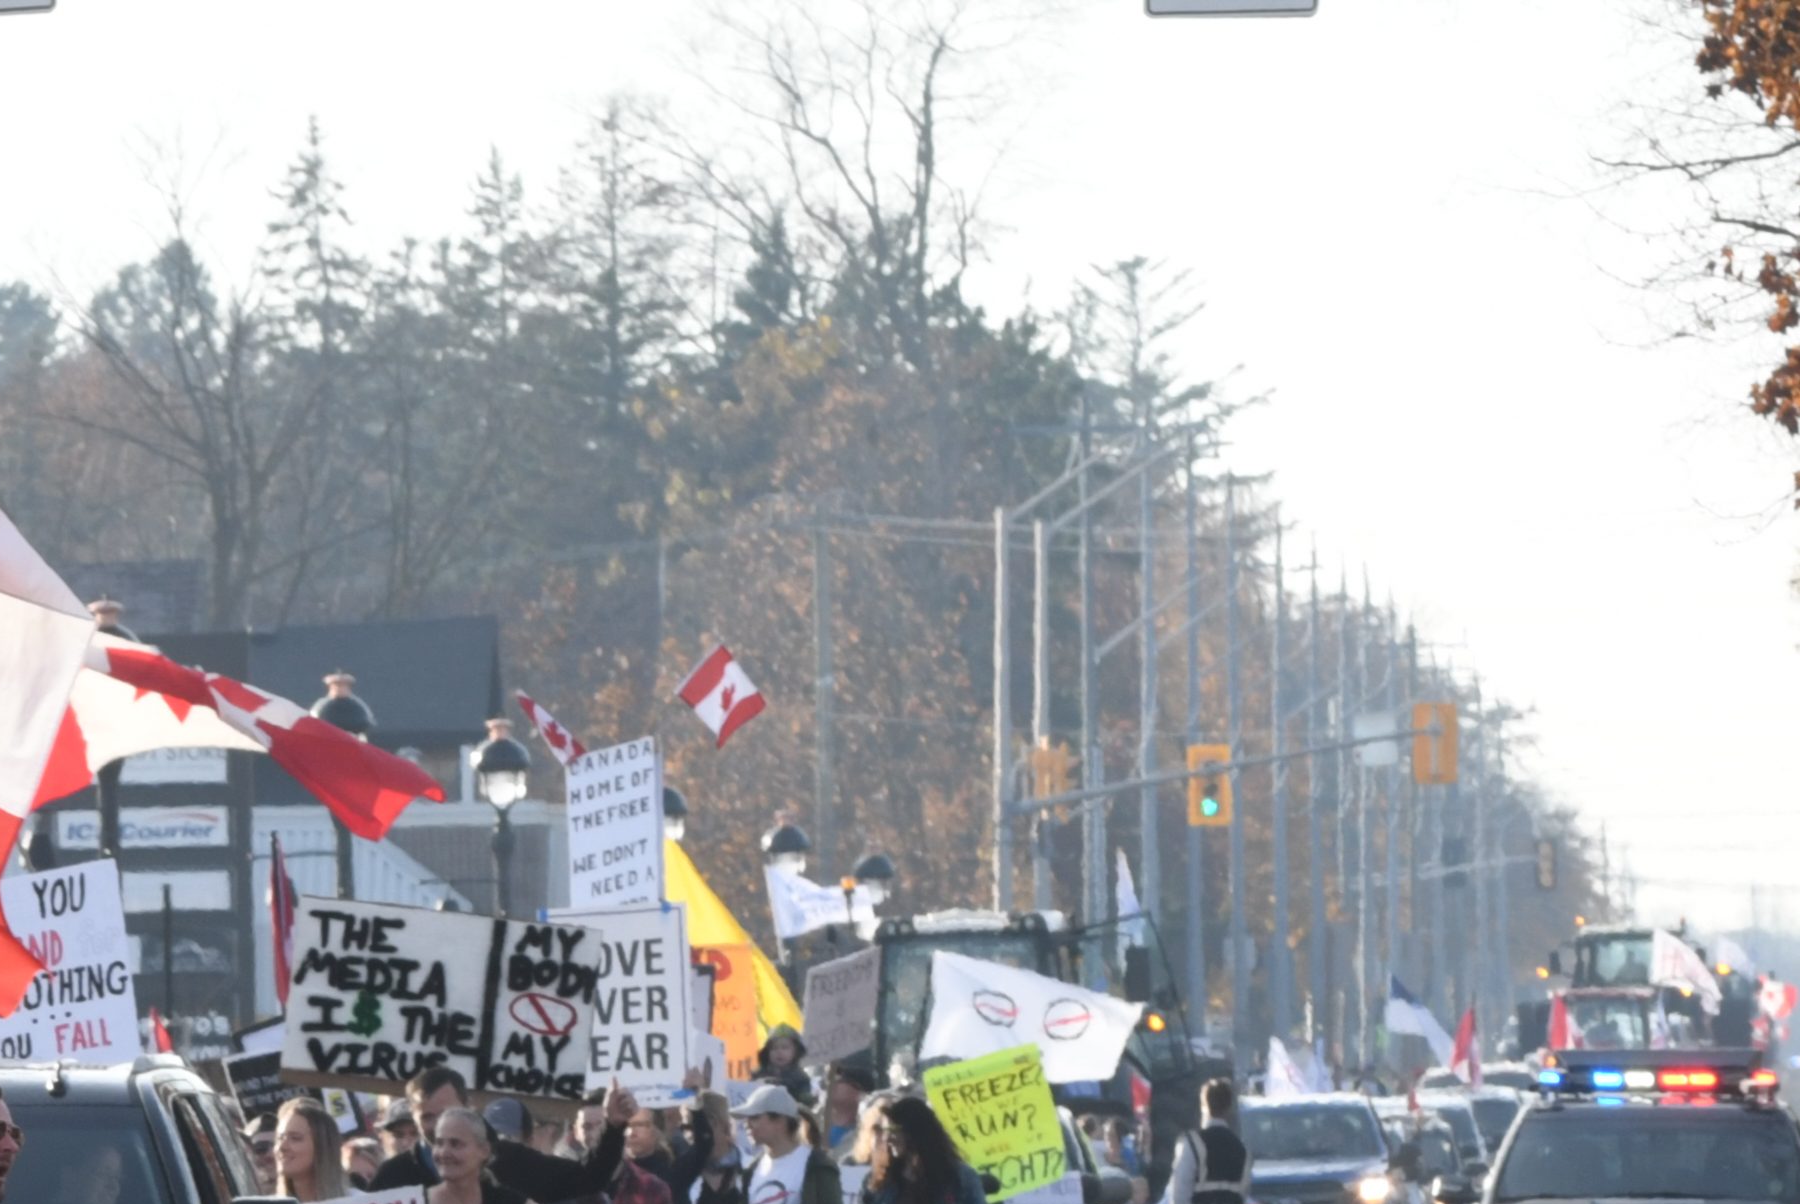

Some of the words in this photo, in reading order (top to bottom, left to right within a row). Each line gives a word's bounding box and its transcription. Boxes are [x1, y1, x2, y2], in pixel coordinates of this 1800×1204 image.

[570, 776, 625, 805] HOME
[631, 767, 653, 788] OF
[573, 853, 597, 875] WE
[590, 870, 639, 899] NEED
[32, 872, 86, 919] YOU
[15, 930, 64, 969] ND
[309, 909, 406, 953] THE
[515, 924, 586, 963] MY
[294, 947, 447, 1008] MEDIA
[600, 937, 666, 979] OVE
[17, 960, 129, 1013] OTHING
[507, 953, 599, 1006] BODY
[594, 985, 670, 1026] VER
[54, 1018, 113, 1055] FALL
[400, 1005, 478, 1057] THE
[501, 1031, 571, 1074] MY
[590, 1032, 670, 1074] EAR
[942, 1062, 1043, 1111] FREEZE?
[955, 1103, 1037, 1143] RUN?
[976, 1147, 1064, 1189] IGHT?
